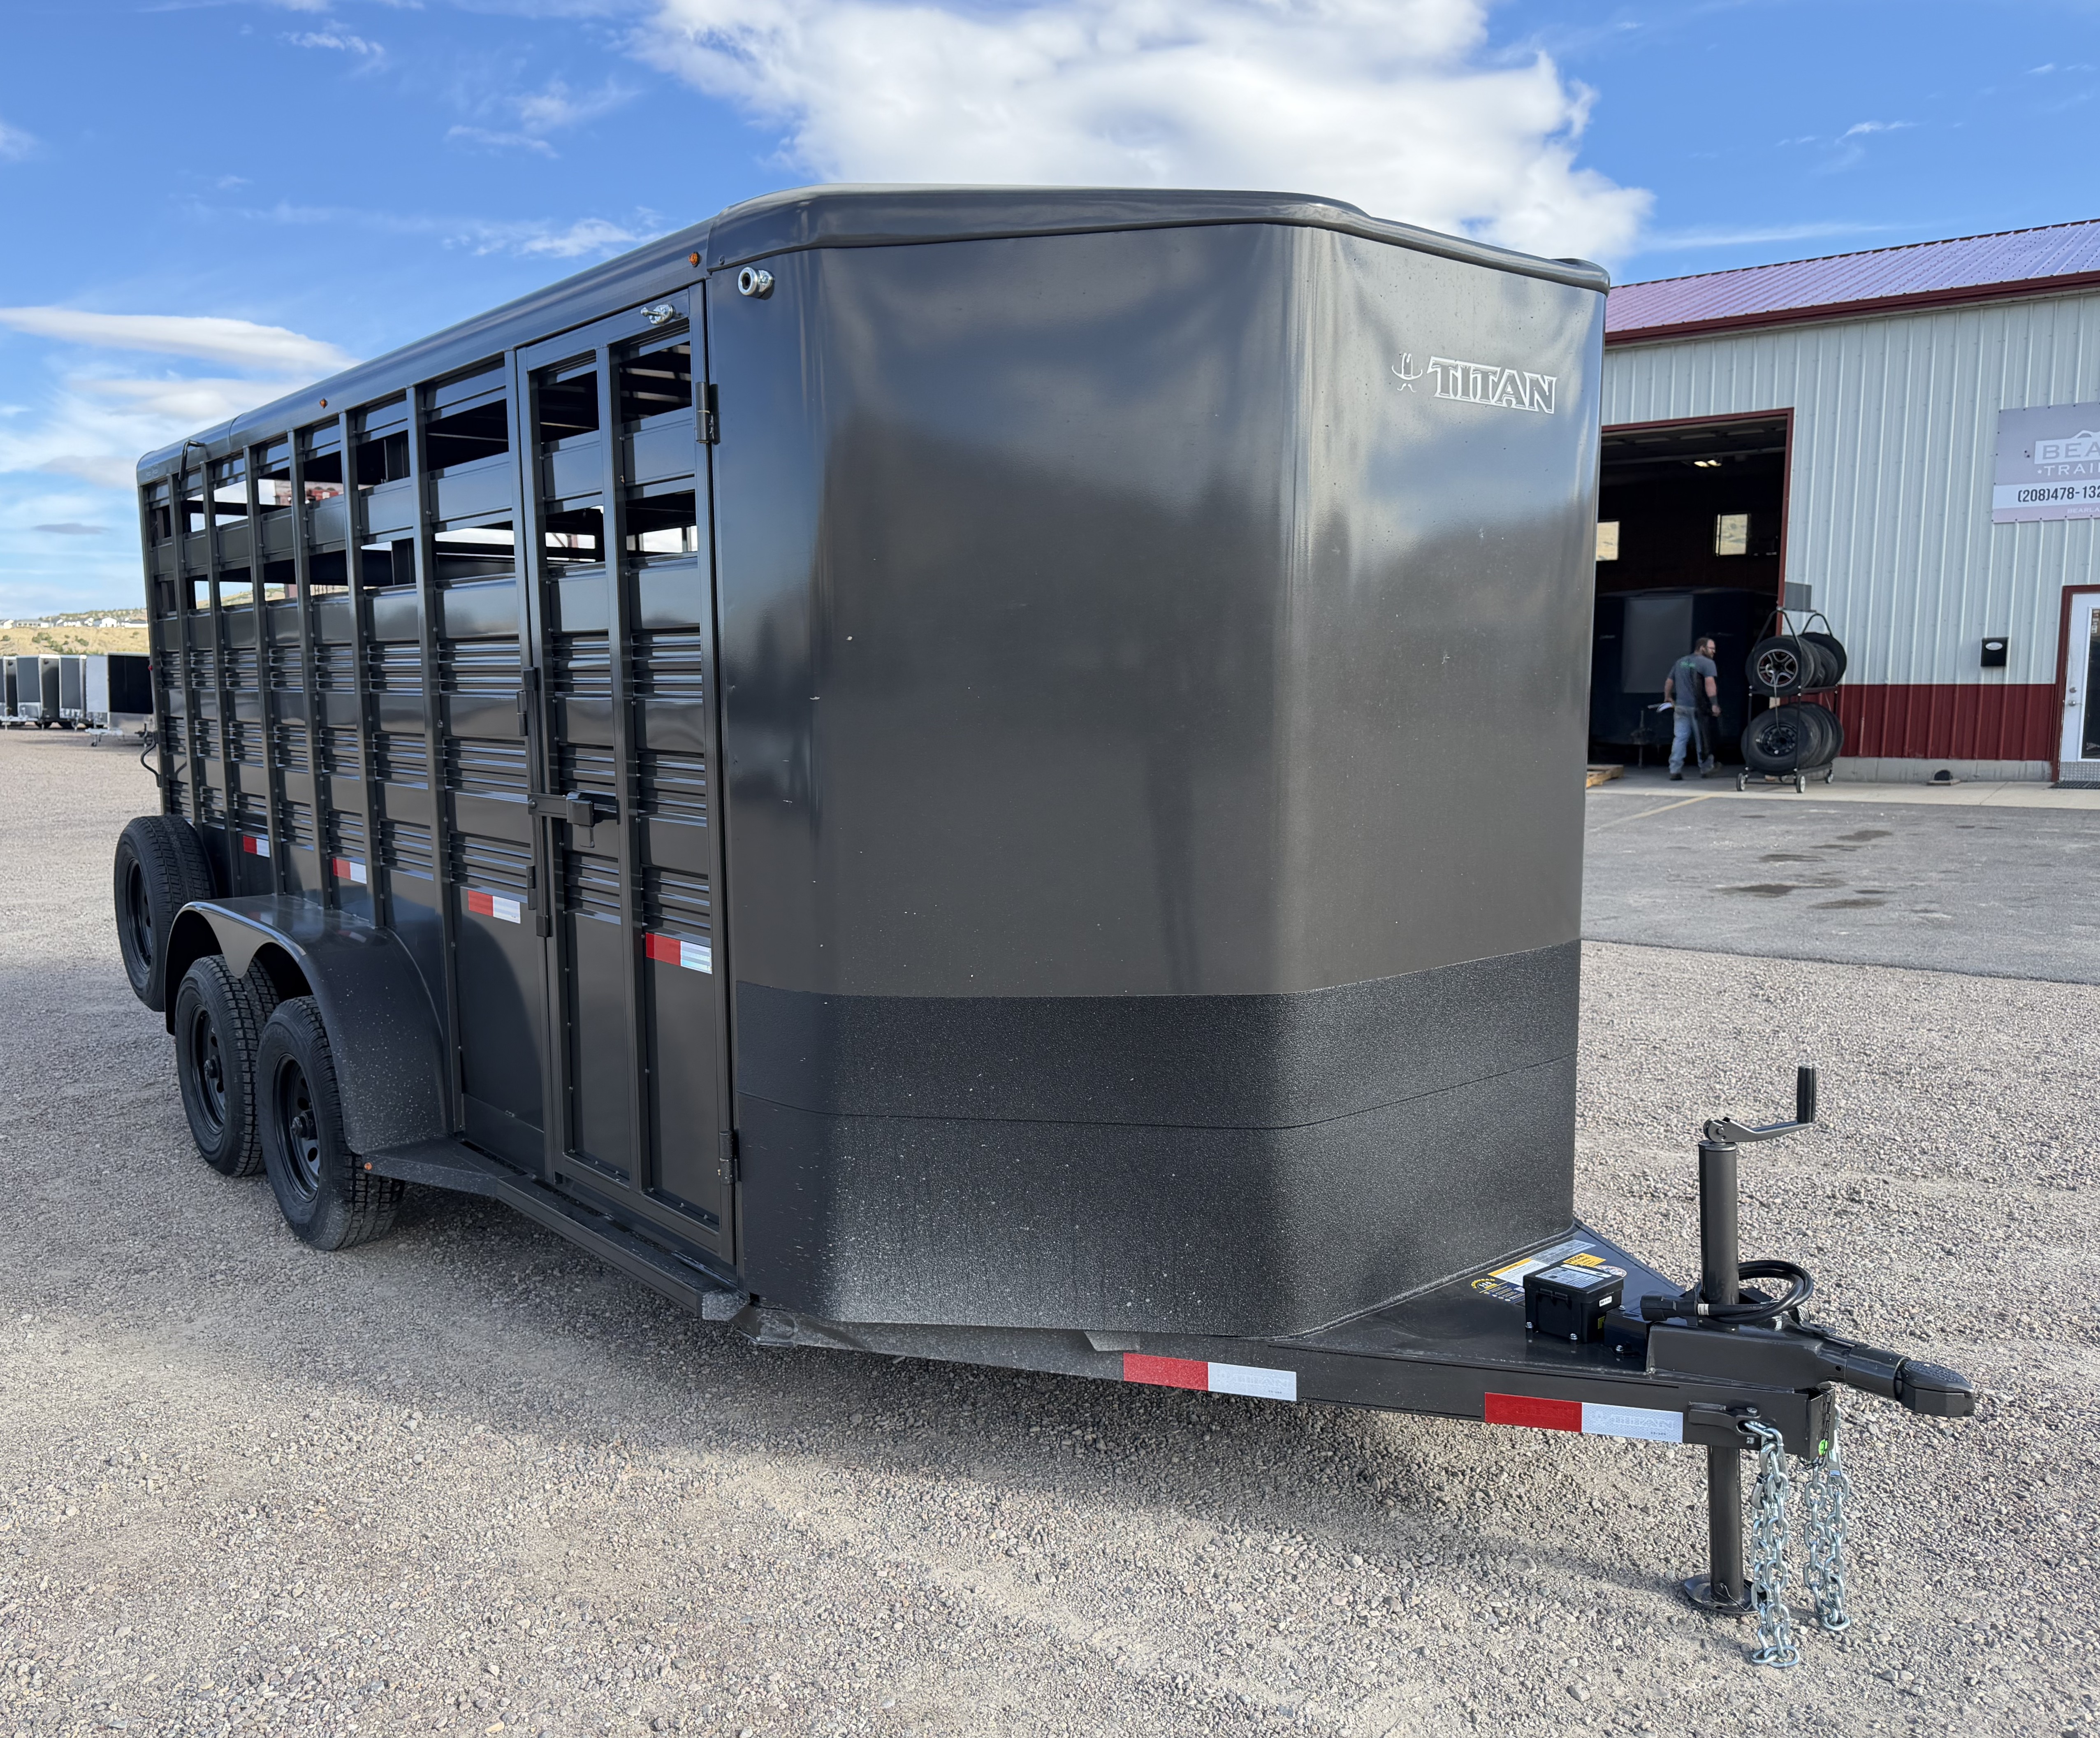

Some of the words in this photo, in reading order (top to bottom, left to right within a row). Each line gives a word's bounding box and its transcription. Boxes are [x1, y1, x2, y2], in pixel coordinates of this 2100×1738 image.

[1426, 356, 1557, 414] TITAN
[2042, 441, 2100, 460] BEA
[1610, 1414, 1674, 1430] TITAN
